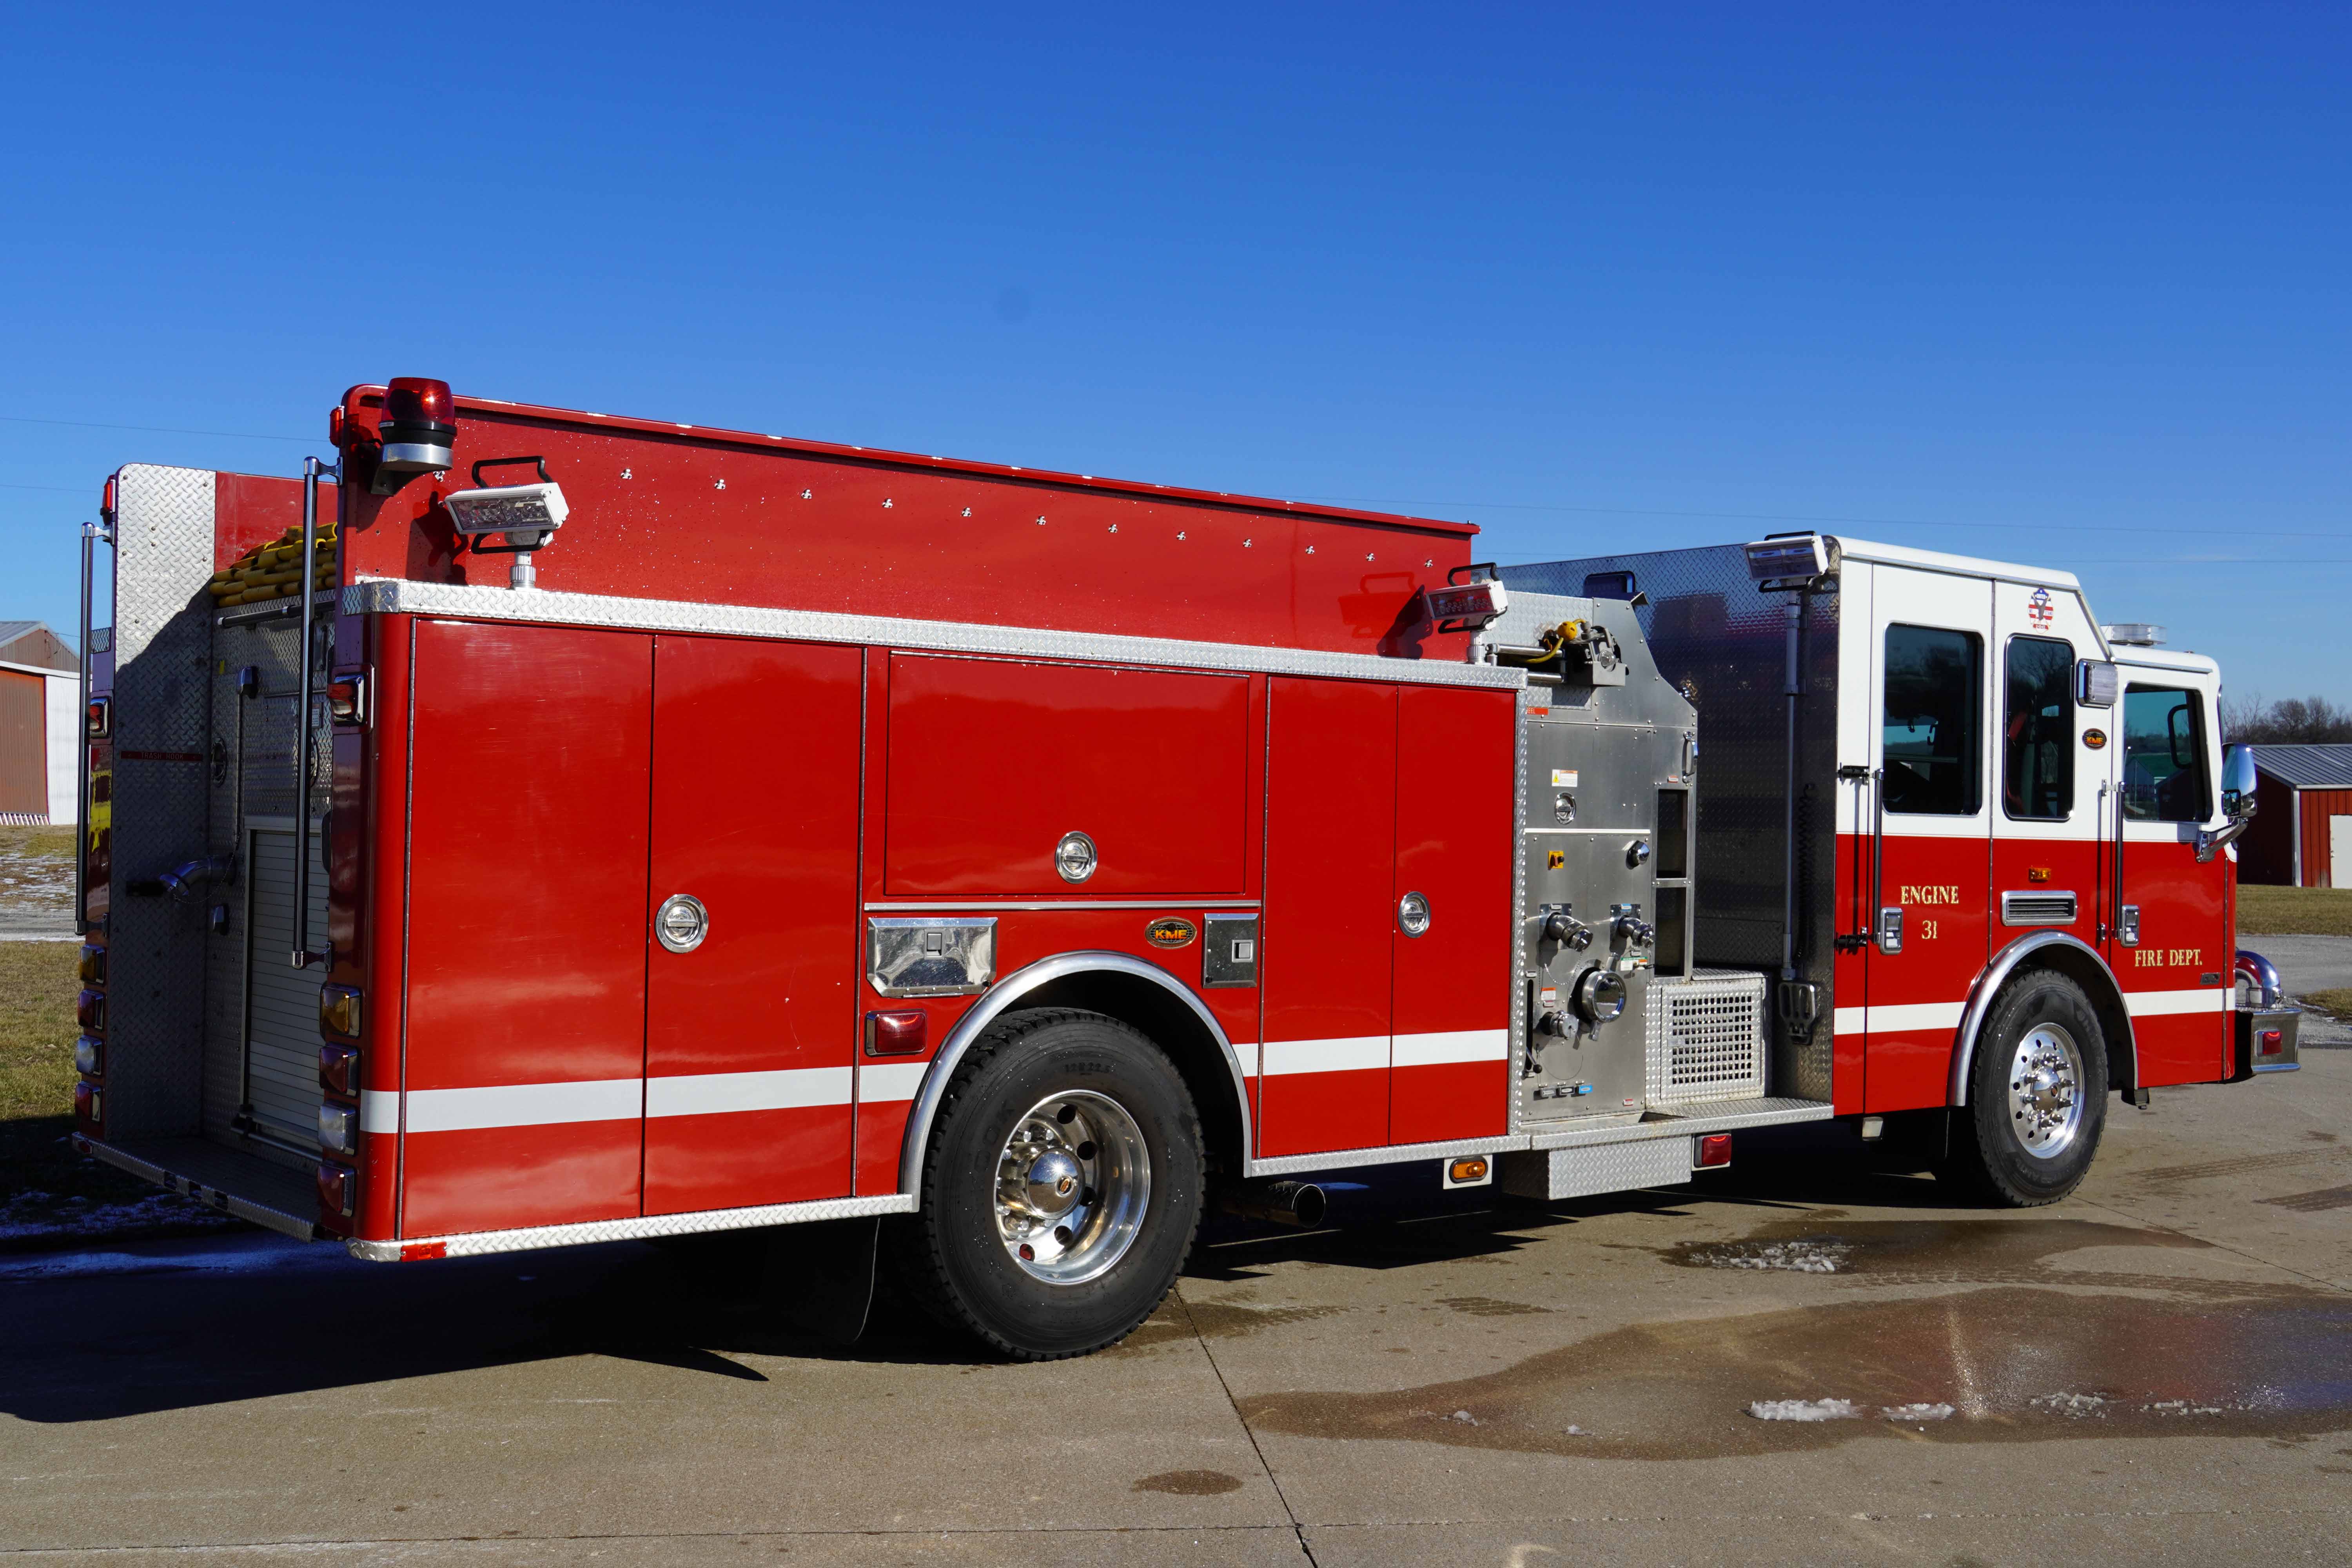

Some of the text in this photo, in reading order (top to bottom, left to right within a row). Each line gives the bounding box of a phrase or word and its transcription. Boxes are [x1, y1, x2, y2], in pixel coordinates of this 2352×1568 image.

[1900, 886, 1959, 904] ENGINE
[1155, 929, 1187, 939] KME
[1922, 920, 1938, 939] 31
[2135, 949, 2203, 967] FIRE DEPT.
